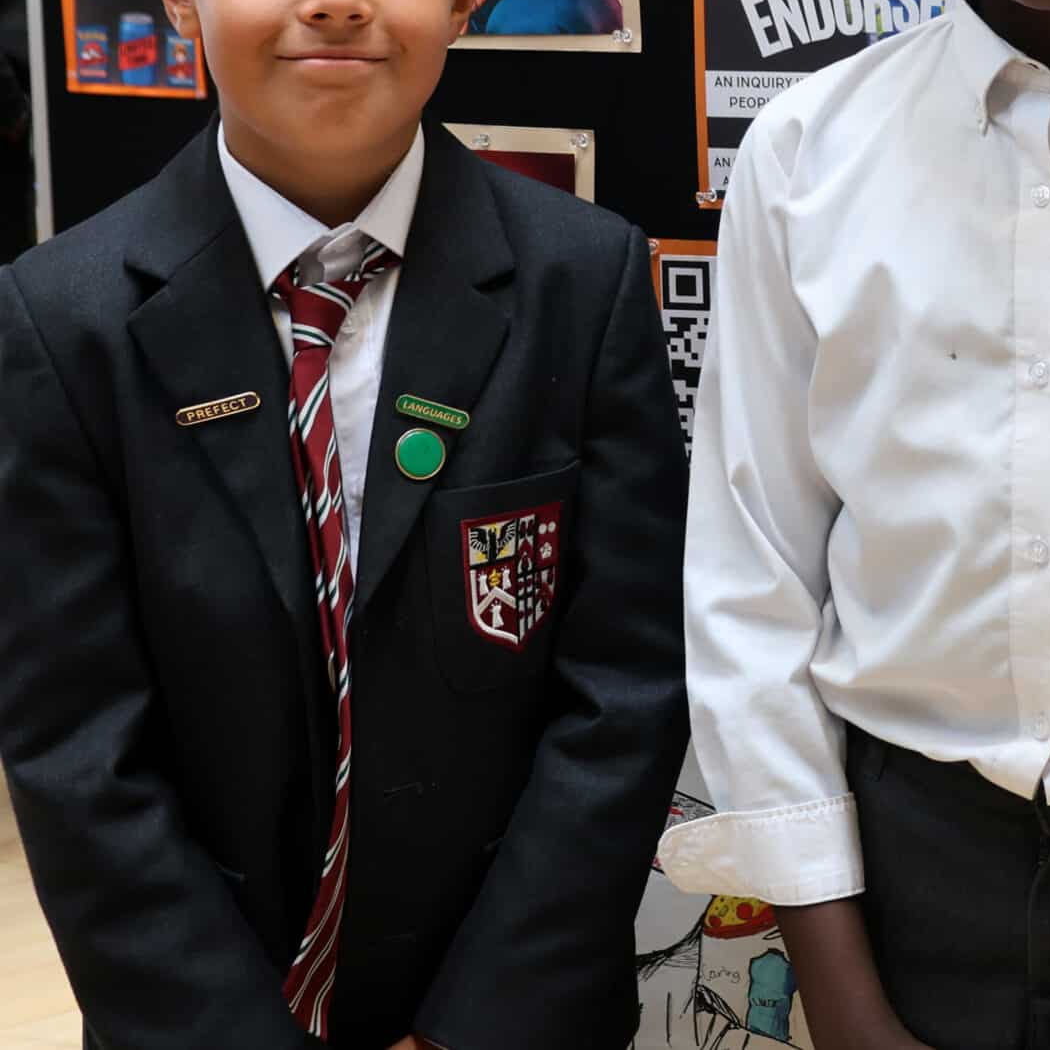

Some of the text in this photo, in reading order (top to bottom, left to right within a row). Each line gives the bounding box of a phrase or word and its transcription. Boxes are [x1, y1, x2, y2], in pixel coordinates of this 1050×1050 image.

[715, 77, 732, 87] AN
[737, 77, 791, 88] INQUIRY
[714, 158, 731, 167] AN
[186, 397, 249, 422] PREFECT
[401, 400, 463, 425] LANGUAGES
